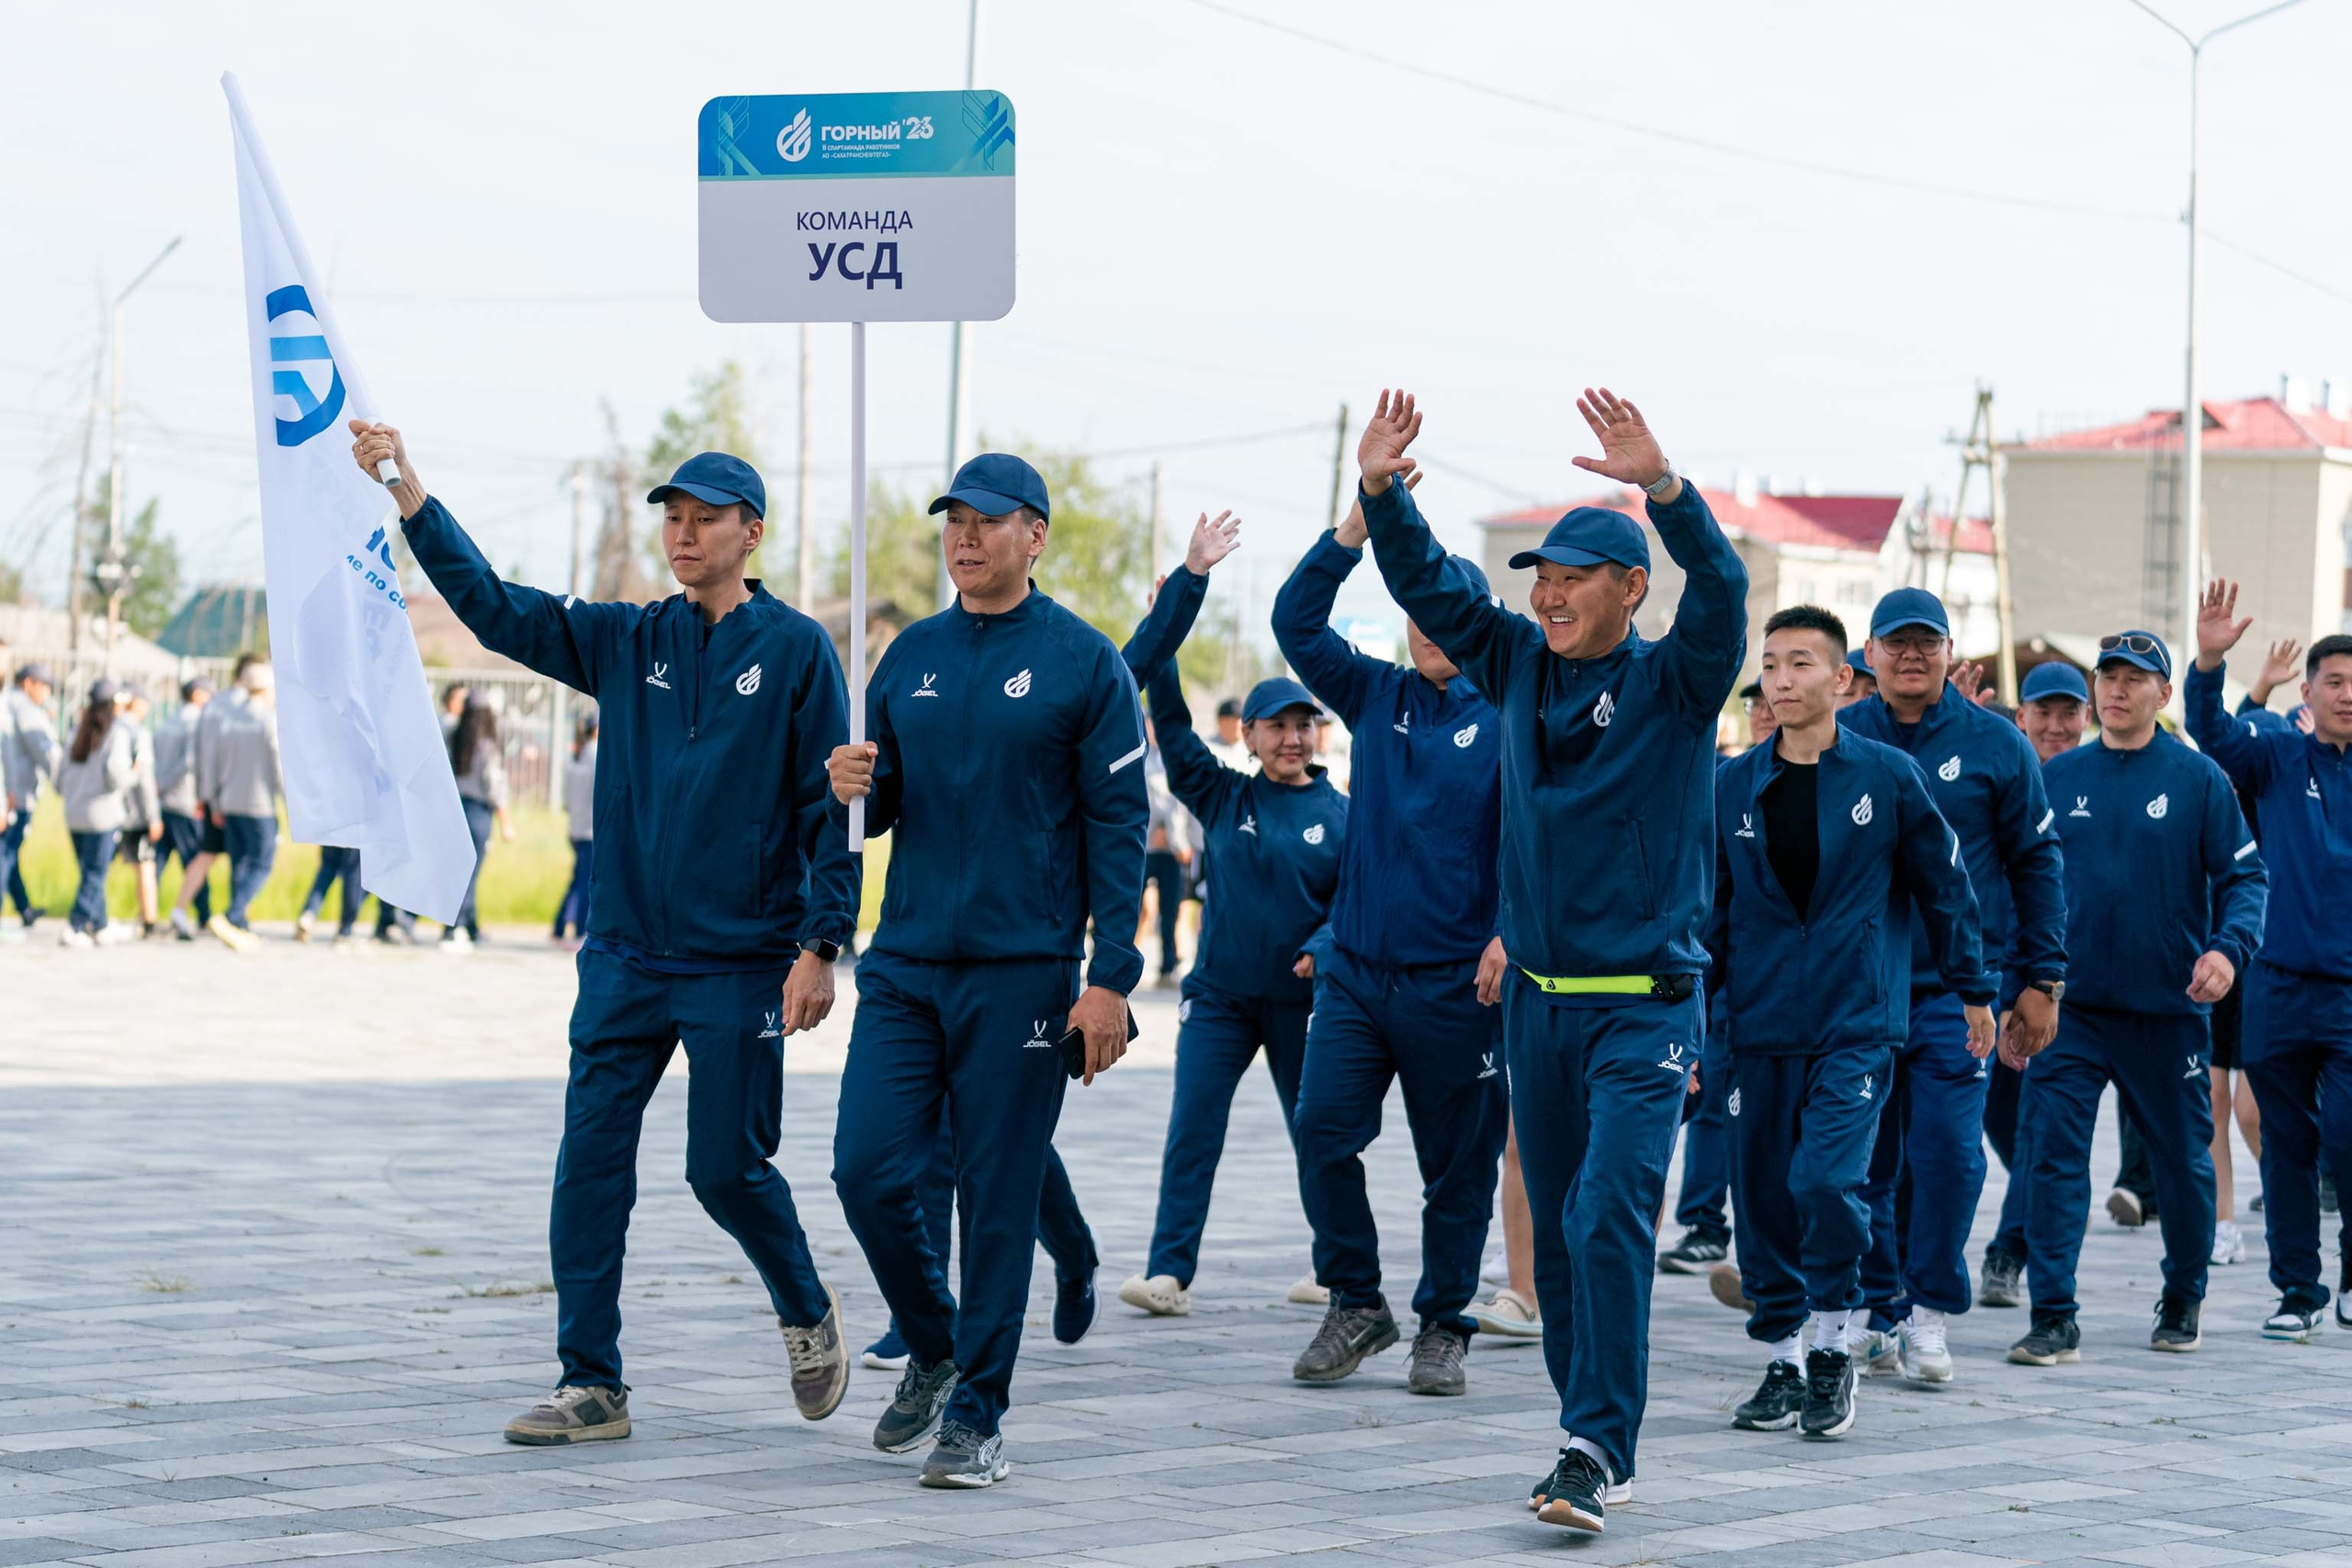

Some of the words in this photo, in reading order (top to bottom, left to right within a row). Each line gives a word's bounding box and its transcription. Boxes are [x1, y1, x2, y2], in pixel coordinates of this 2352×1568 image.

[821, 120, 900, 141] ГОРНЫЙ
[797, 210, 913, 234] КОМАНДА
[808, 242, 903, 290] УСД
[365, 570, 386, 591] по
[910, 689, 938, 698] JÖGEL
[1022, 1039, 1052, 1048] JÖGEL
